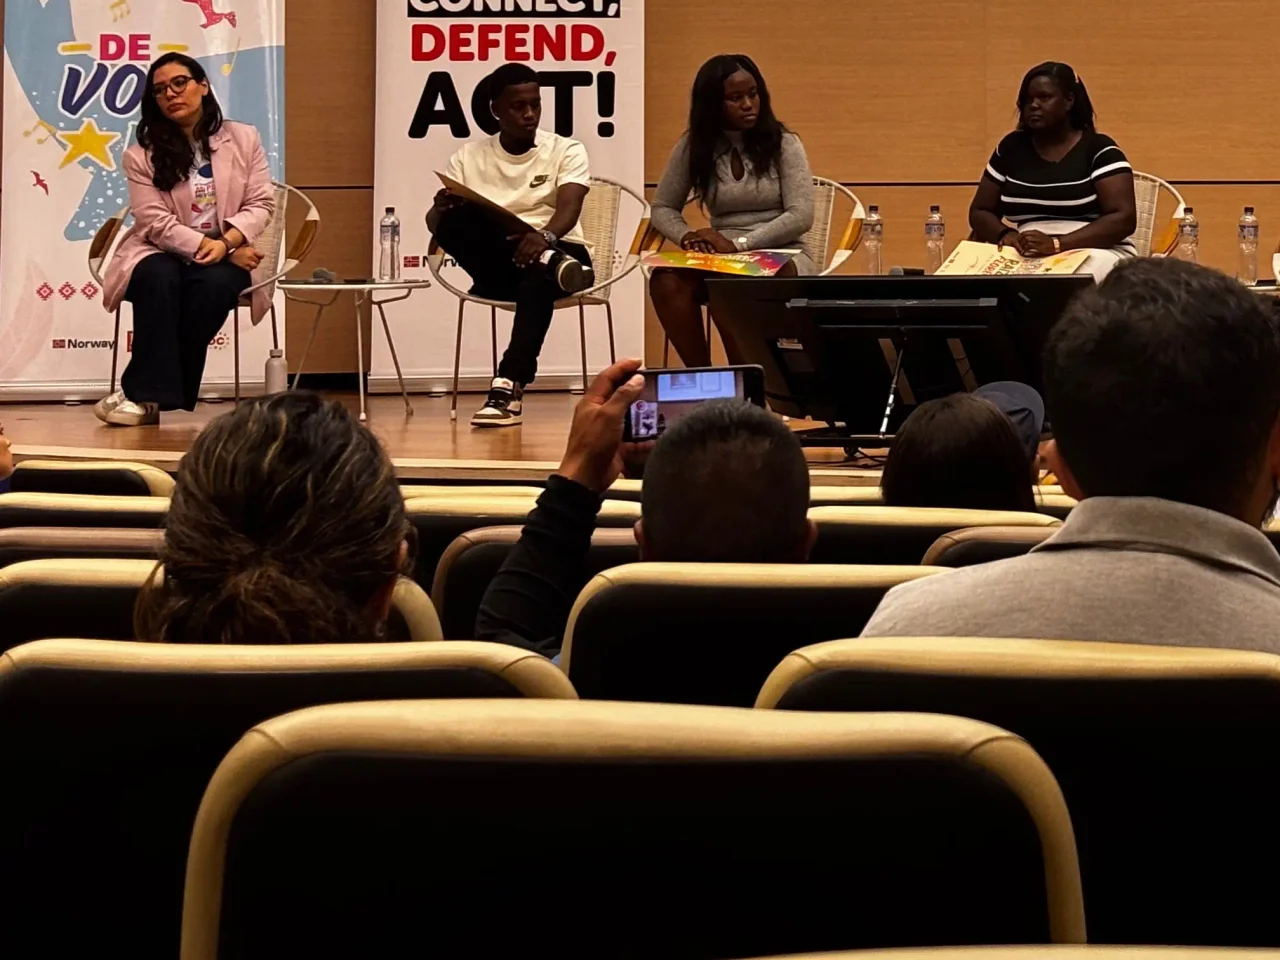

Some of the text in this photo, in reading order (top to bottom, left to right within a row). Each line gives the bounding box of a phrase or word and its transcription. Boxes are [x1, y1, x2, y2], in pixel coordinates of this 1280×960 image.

[100, 34, 151, 61] DE
[411, 24, 617, 66] DEFEND,
[61, 62, 148, 116] VO
[68, 339, 116, 350] Norway
